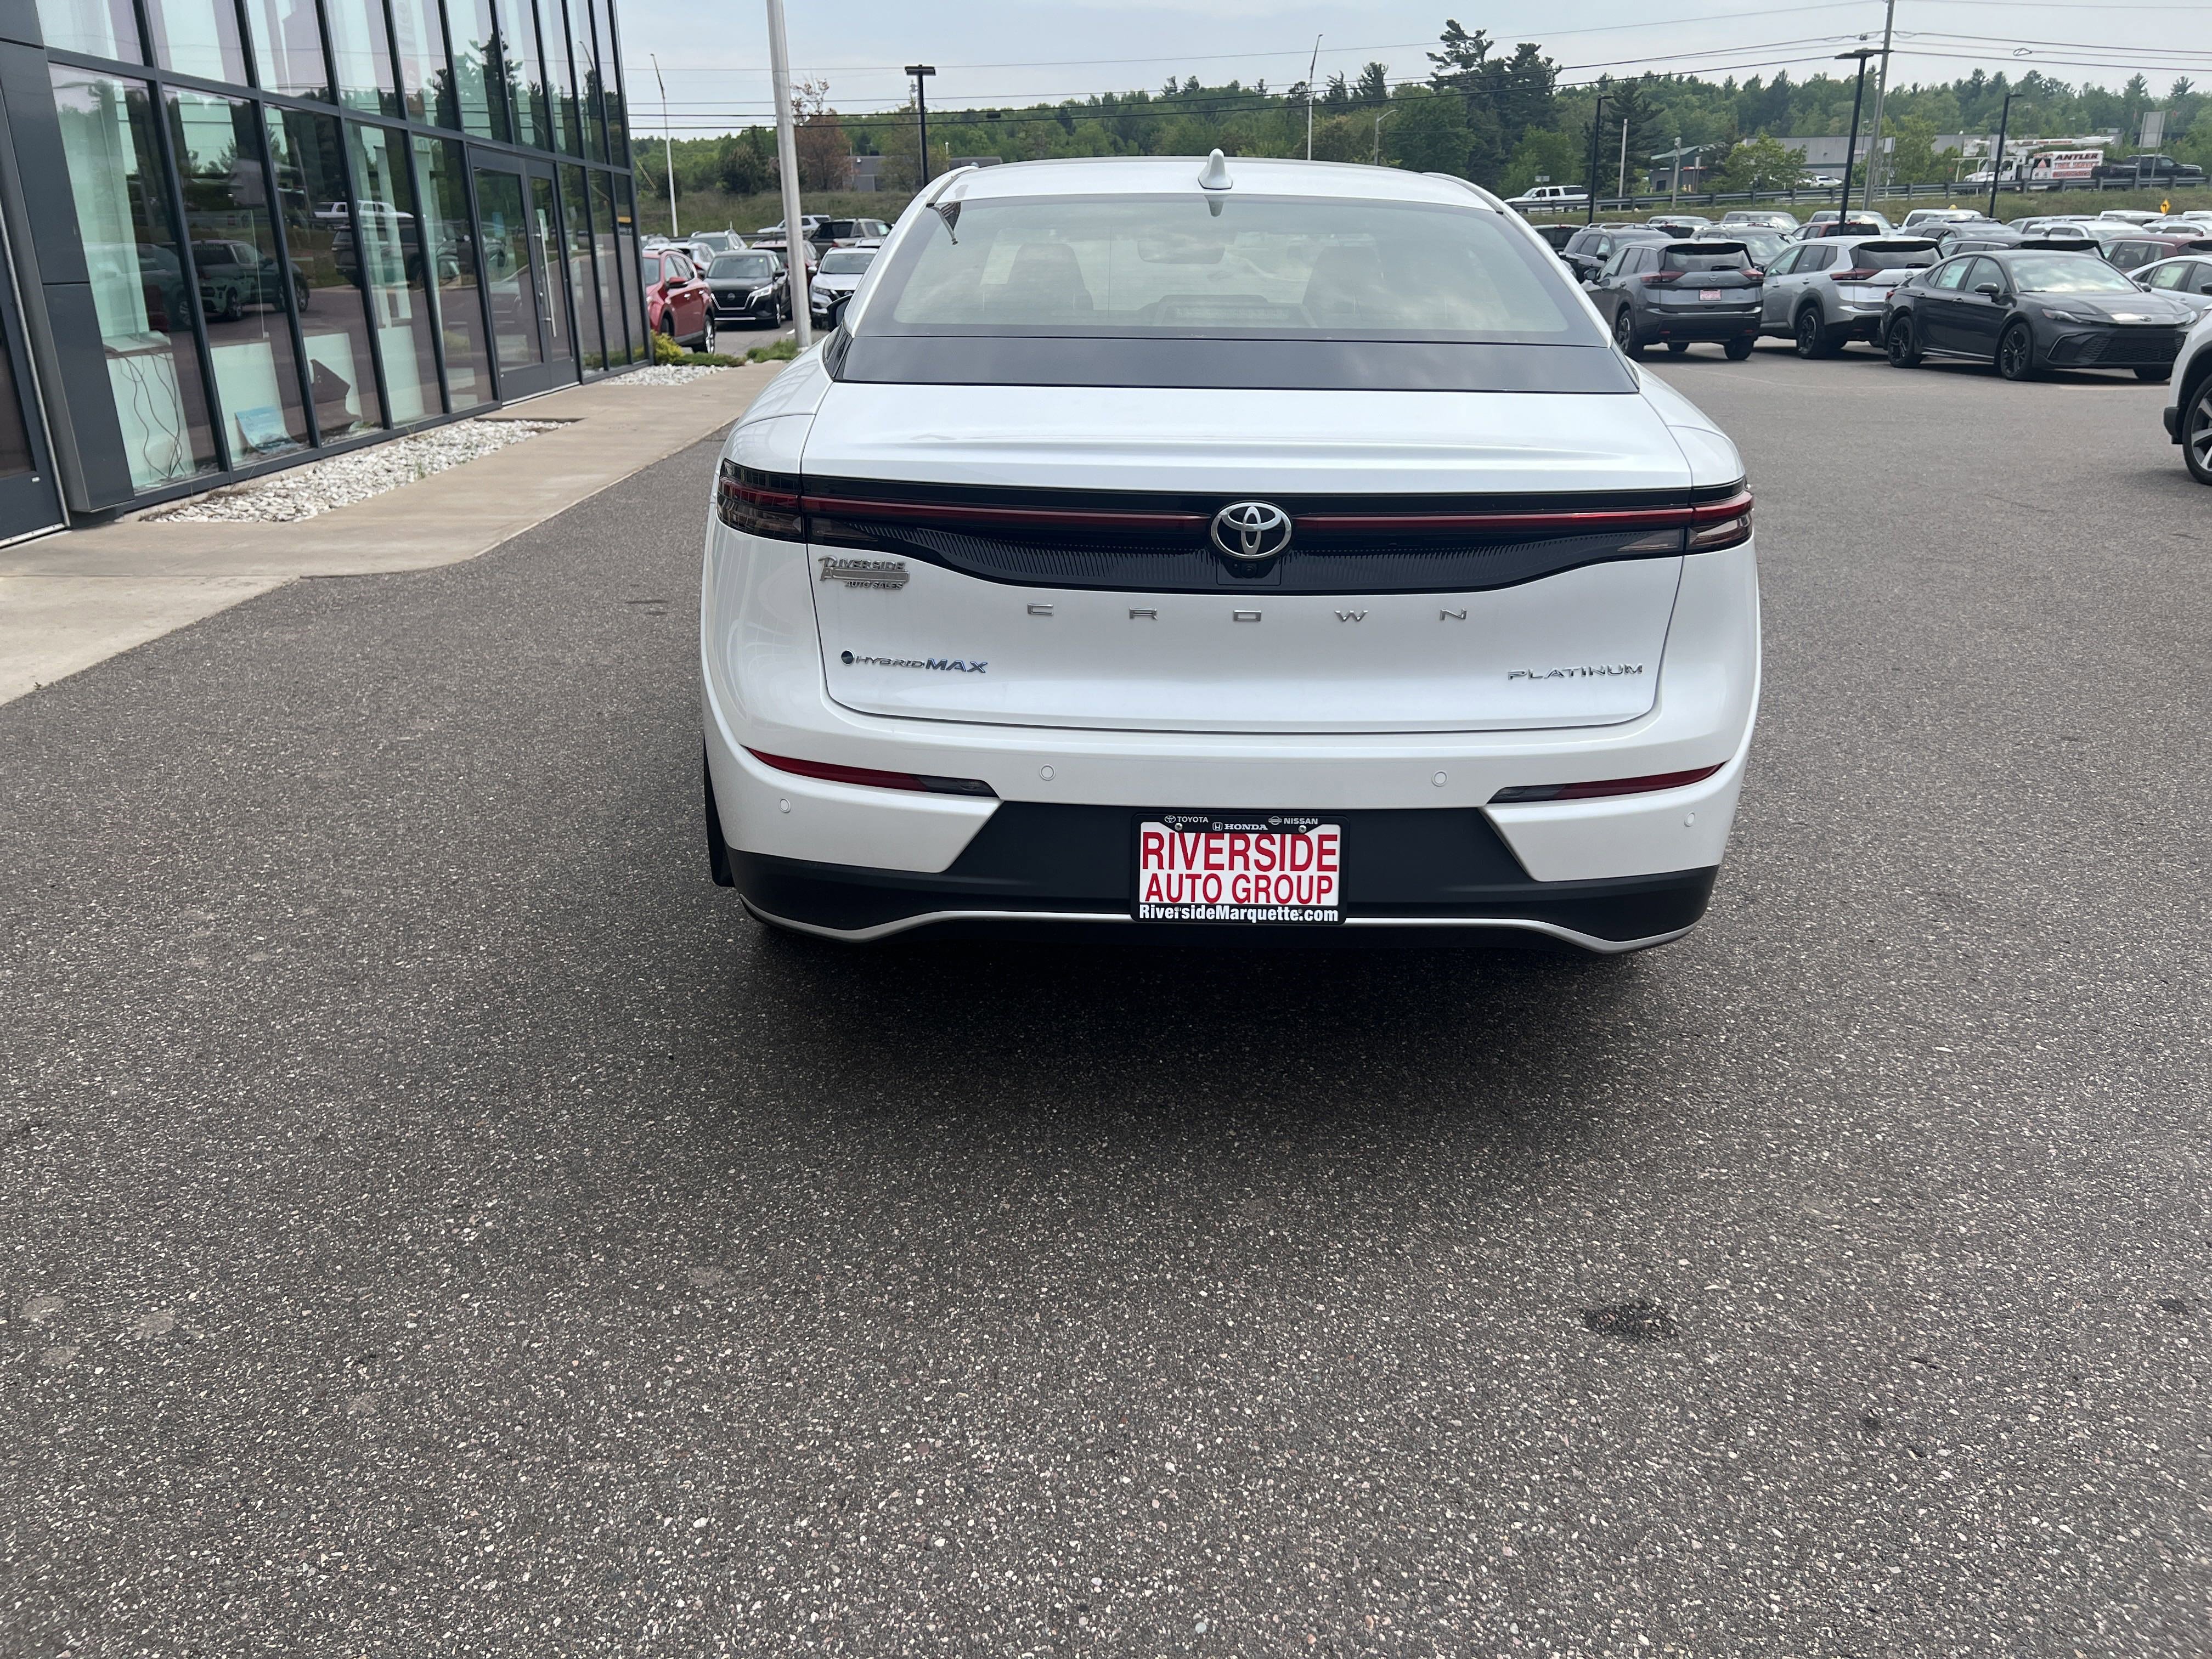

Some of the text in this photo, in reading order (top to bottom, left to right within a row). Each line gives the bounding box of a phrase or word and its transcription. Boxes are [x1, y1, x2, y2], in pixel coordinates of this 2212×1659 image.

[818, 555, 907, 580] RIVERSIDE
[845, 580, 871, 589] AUTO
[1027, 603, 1468, 622] CROWN
[1508, 663, 1643, 680] PLATINUM
[1142, 832, 1338, 872] RIVERSIDE
[1145, 873, 1333, 904] AUTO GROUP
[1139, 904, 1339, 923] RiversideMarquette.com
